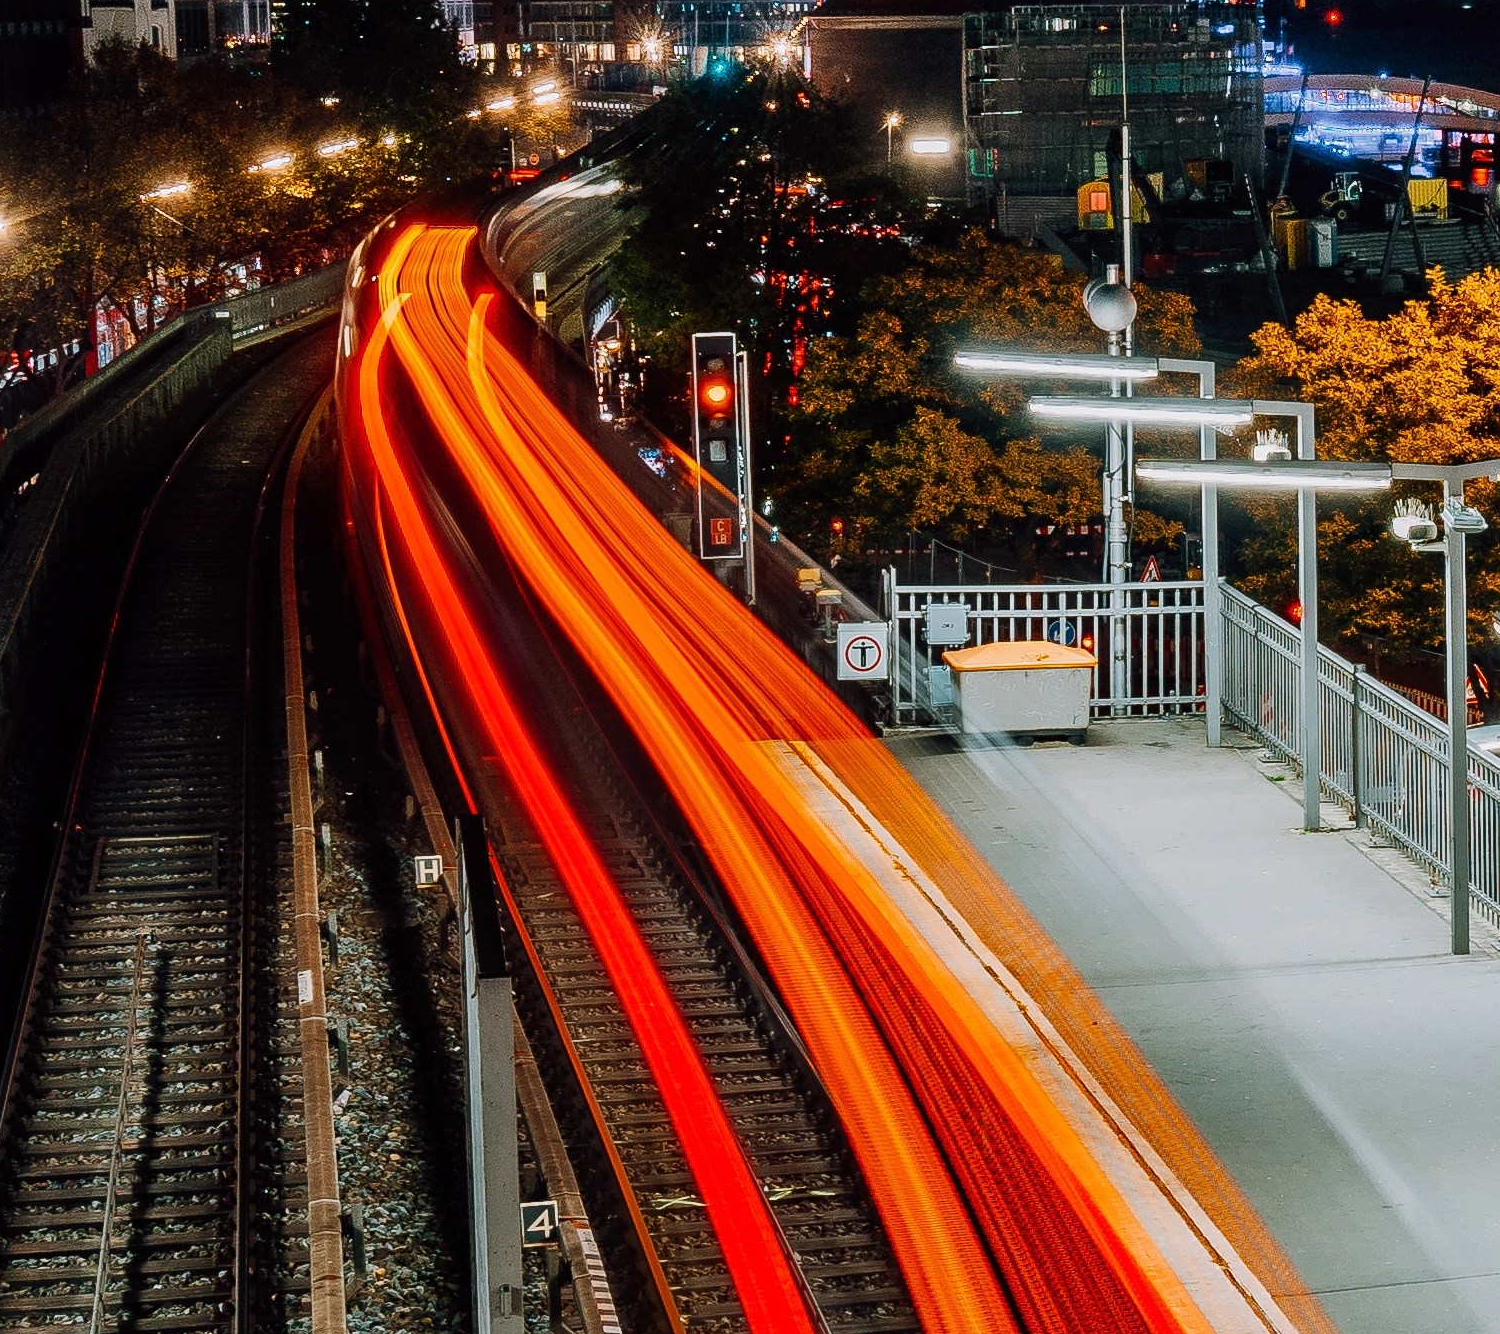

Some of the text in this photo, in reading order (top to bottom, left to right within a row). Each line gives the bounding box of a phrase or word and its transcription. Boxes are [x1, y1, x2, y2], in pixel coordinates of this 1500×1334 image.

[717, 520, 725, 532] C
[419, 860, 435, 881] H
[527, 1208, 553, 1238] 4
